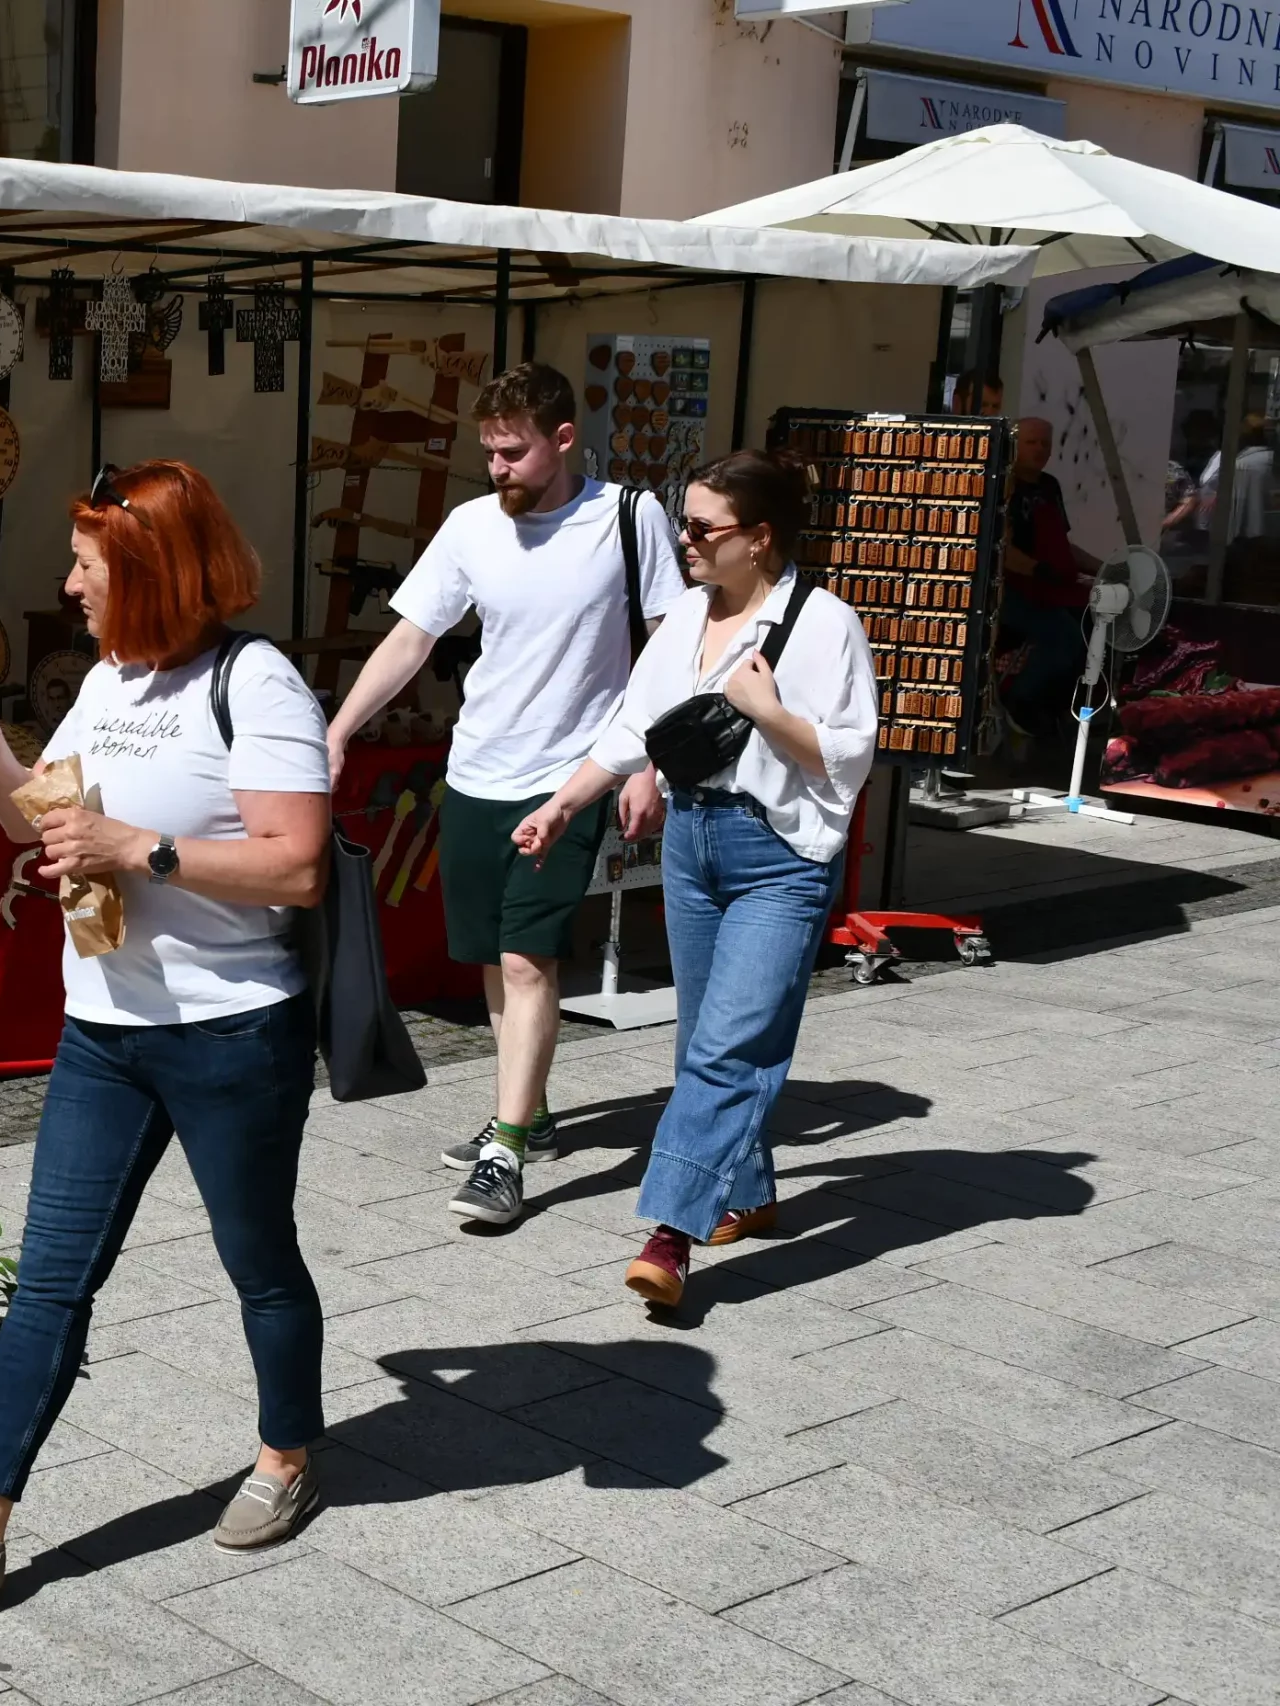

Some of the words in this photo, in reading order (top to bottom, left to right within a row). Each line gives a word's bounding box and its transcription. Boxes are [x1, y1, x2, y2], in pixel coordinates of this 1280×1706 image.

[299, 37, 402, 90] Planika
[123, 302, 147, 315] DOM
[101, 357, 129, 369] KOJI
[92, 708, 183, 739] incredible
[88, 736, 158, 760] women
